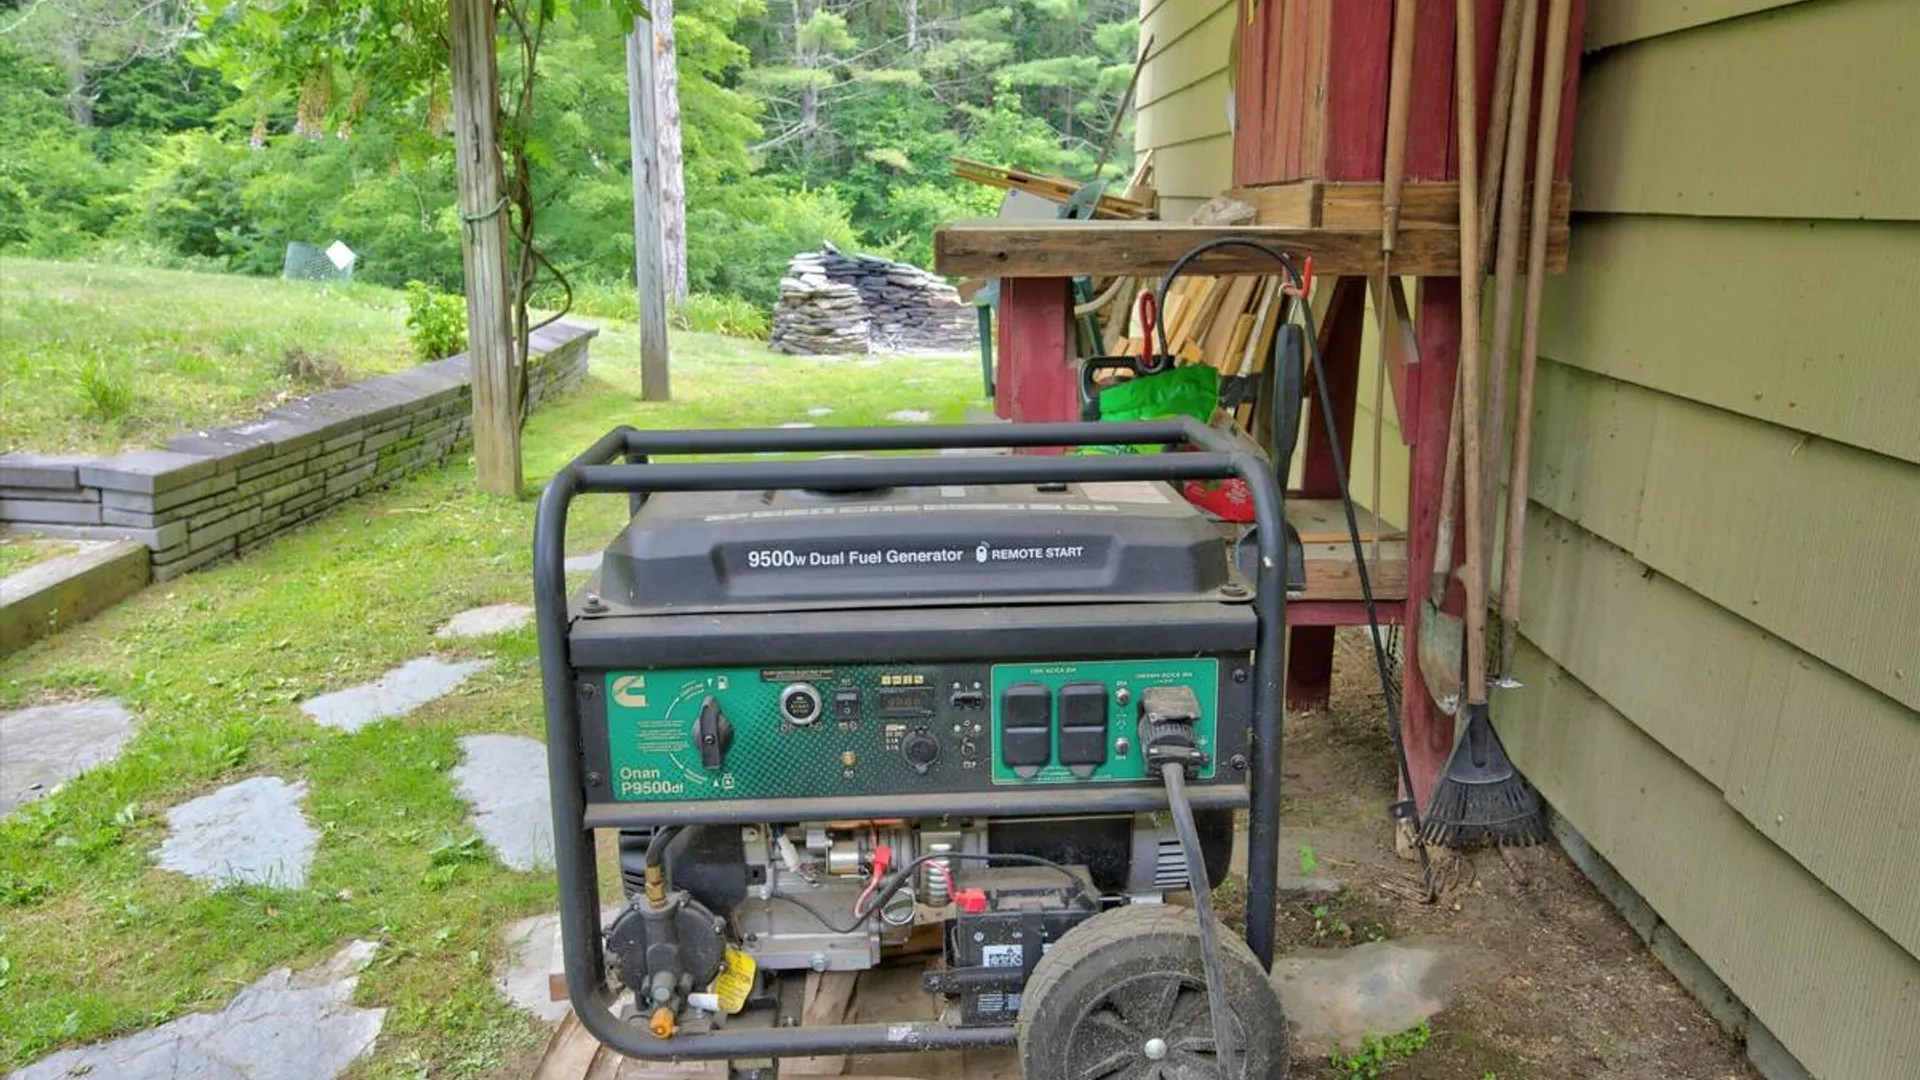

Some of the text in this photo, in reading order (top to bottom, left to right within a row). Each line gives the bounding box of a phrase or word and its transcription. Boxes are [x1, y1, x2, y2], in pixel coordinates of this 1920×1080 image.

[748, 548, 963, 567] 9500w Dual Fuel Generator
[992, 546, 1083, 560] REMOTE START
[620, 767, 660, 779] Onan
[621, 780, 684, 795] P9500df
